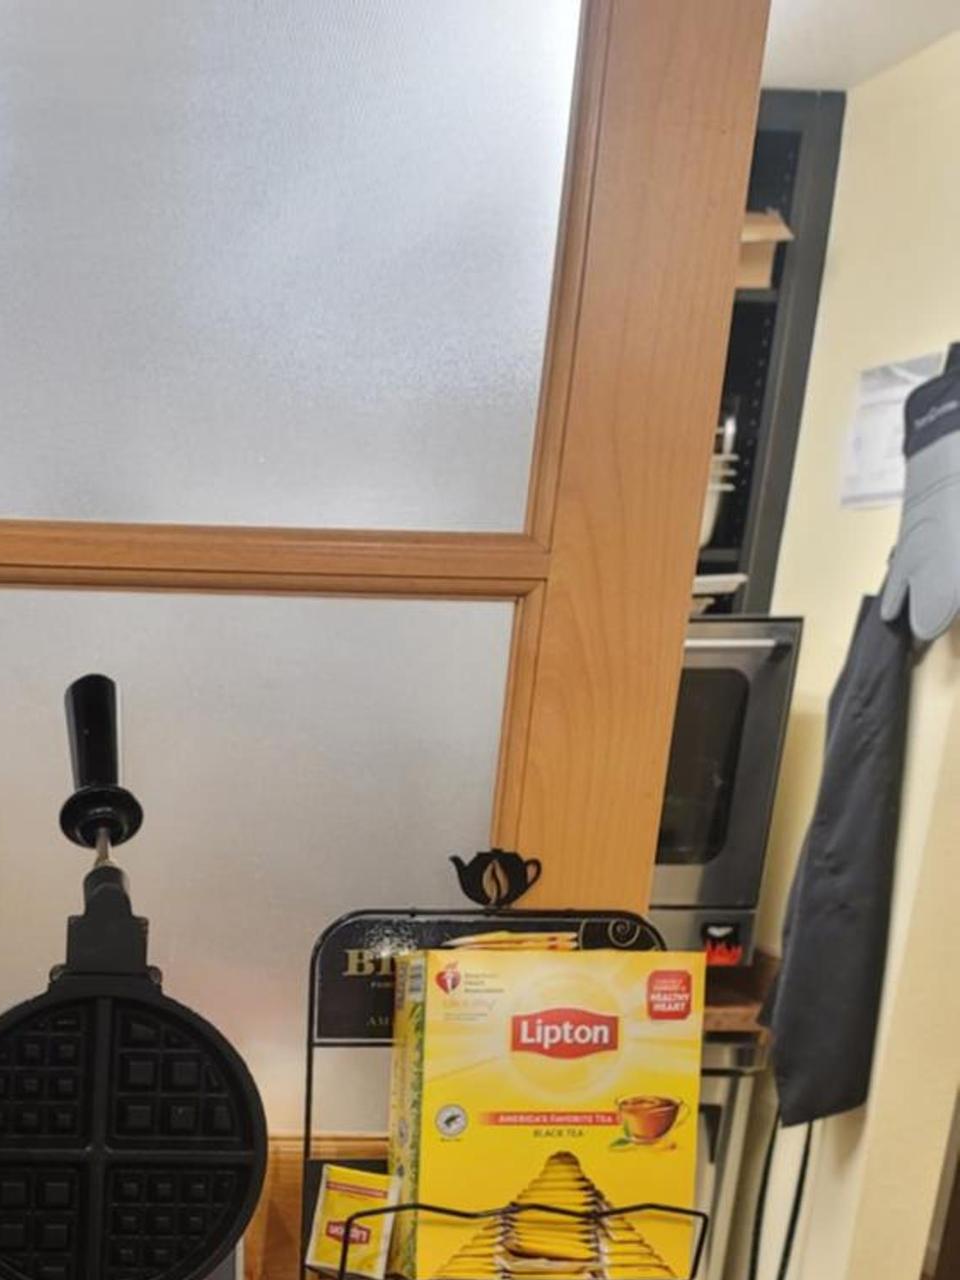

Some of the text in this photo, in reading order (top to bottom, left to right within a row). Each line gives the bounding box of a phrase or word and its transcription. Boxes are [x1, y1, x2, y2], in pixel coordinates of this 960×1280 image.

[519, 1018, 610, 1050] Lipton
[594, 1114, 614, 1124] TEA
[533, 1128, 584, 1138] BLACK TEA
